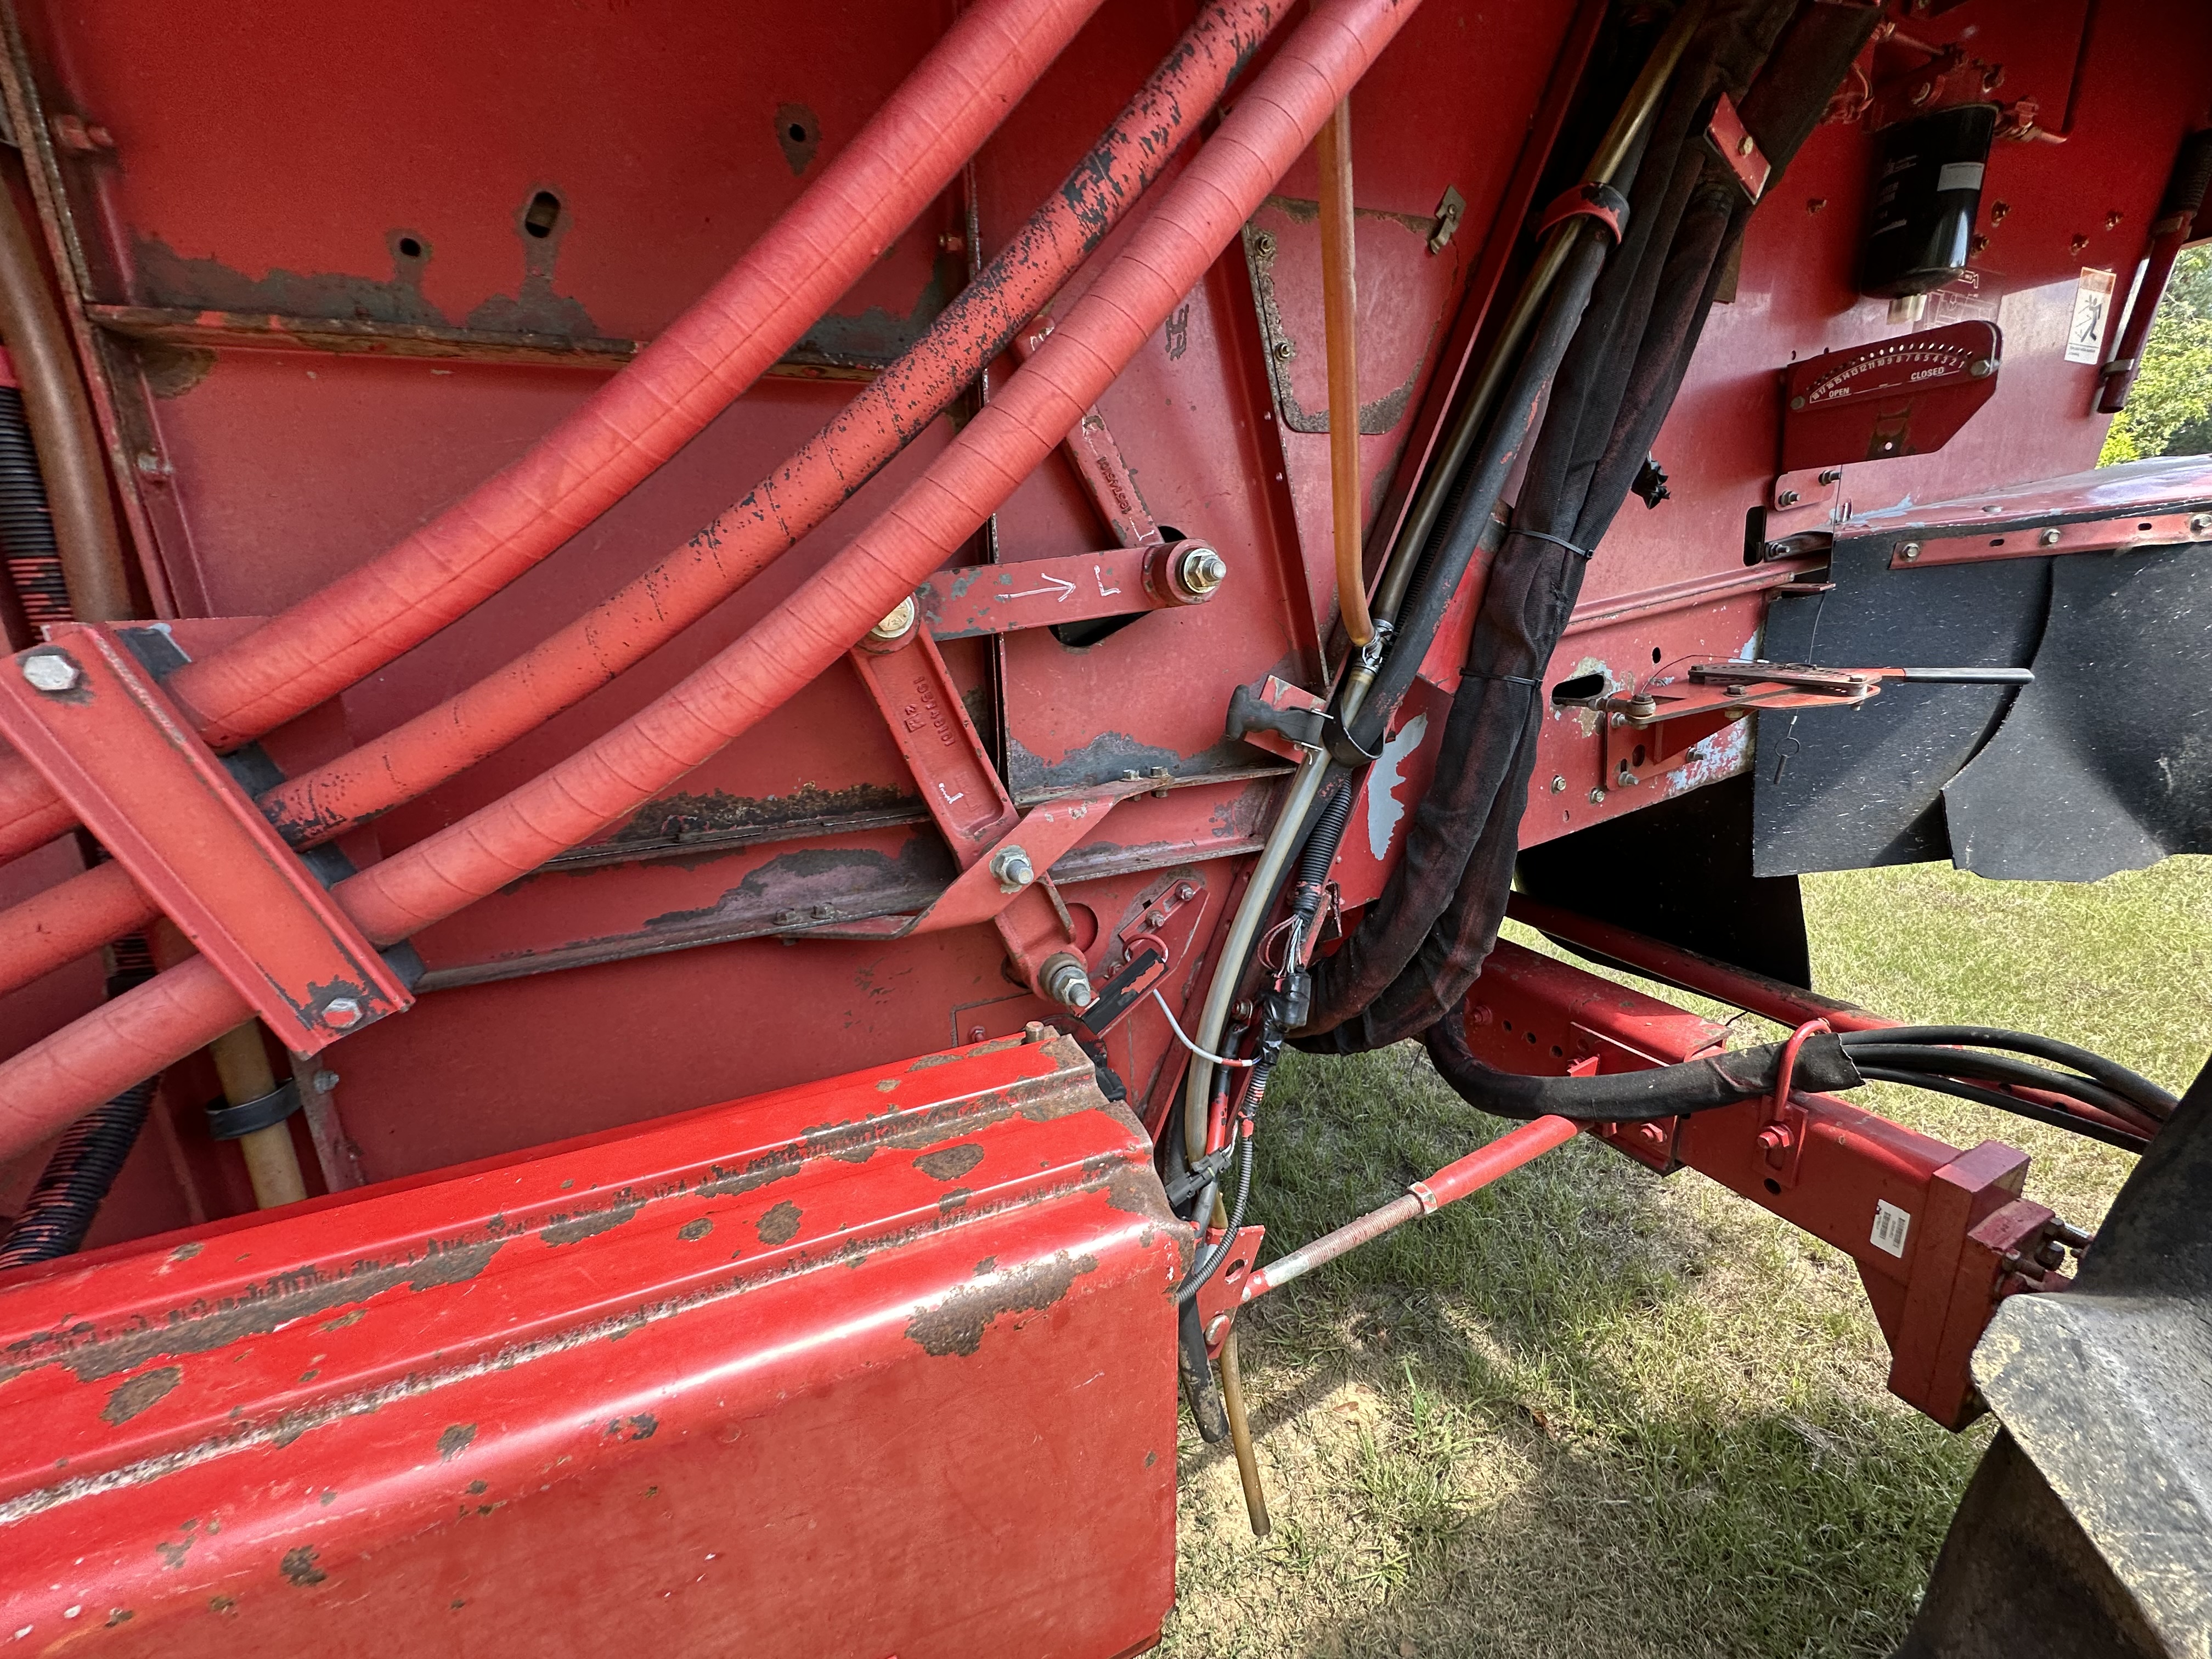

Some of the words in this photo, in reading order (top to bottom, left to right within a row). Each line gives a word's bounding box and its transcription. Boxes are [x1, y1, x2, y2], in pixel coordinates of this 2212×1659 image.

[1829, 387, 1850, 397] OPEN
[1910, 366, 1945, 380] CLOSED
[1850, 368, 1858, 376] 13
[1859, 364, 1867, 373] 12
[1949, 357, 1956, 366] 2
[1958, 360, 1965, 369] 1
[1094, 565, 1121, 596] L
